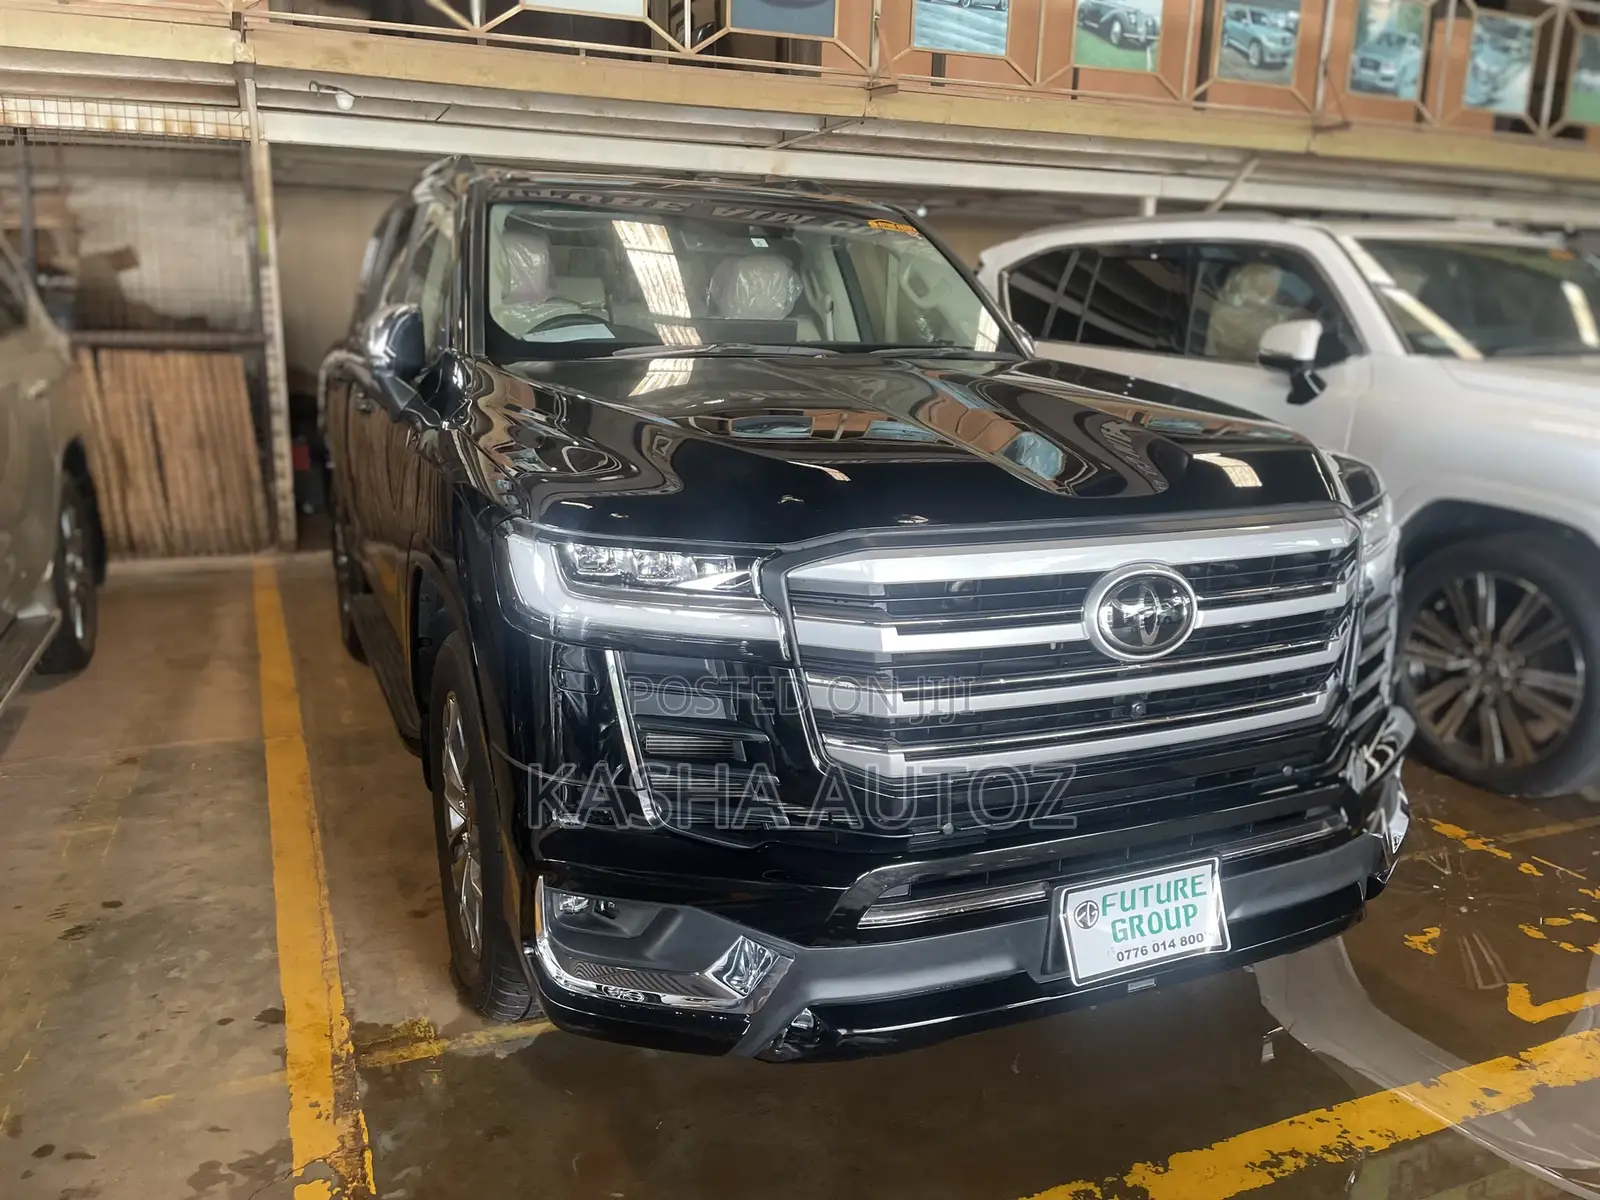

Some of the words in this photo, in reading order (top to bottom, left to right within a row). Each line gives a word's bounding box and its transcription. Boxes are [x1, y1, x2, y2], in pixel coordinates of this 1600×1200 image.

[1101, 873, 1208, 917] FUTURE
[1110, 903, 1199, 944] GROUP
[1116, 945, 1149, 962] 0776
[1152, 939, 1177, 953] 014
[1180, 932, 1205, 948] 800
